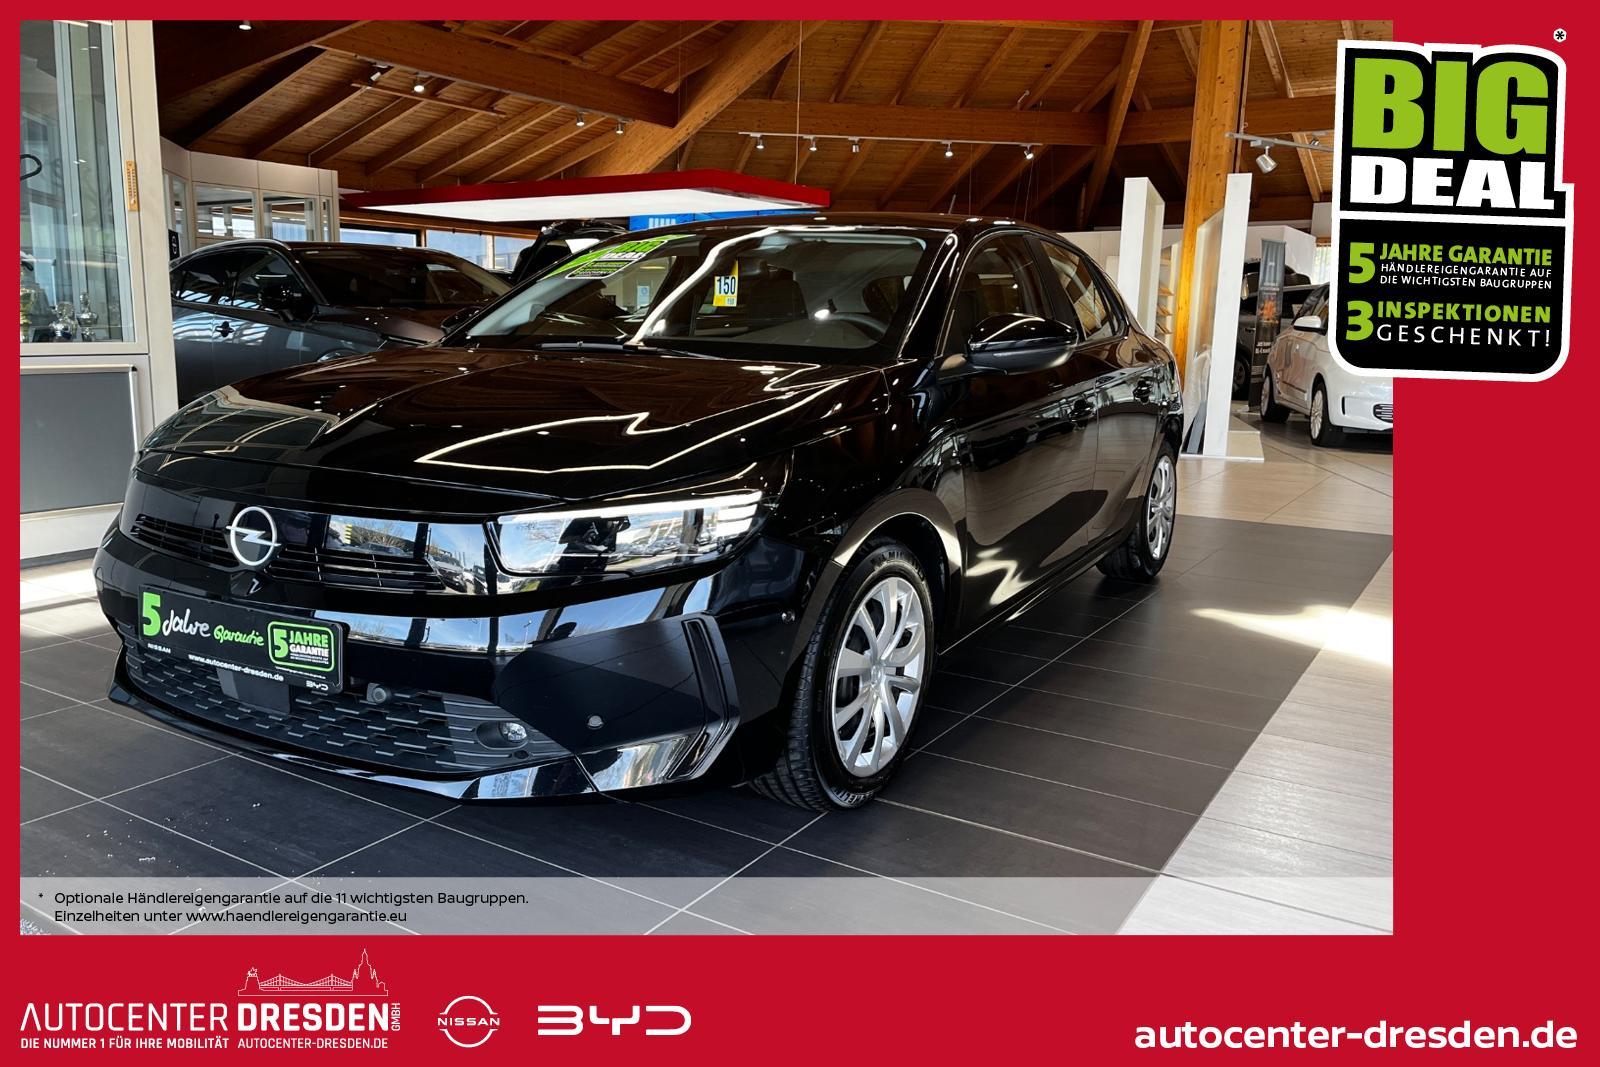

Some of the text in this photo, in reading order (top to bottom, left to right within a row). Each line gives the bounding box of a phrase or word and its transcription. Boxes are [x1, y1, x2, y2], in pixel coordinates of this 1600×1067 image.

[717, 276, 736, 295] 150
[142, 591, 264, 646] 5 Jahre Garantie
[147, 643, 172, 654] NISSAN
[273, 628, 328, 658] 5 JAHRE
[289, 644, 329, 658] GARANTIE
[188, 653, 284, 682] www.autocenter-dresden.de
